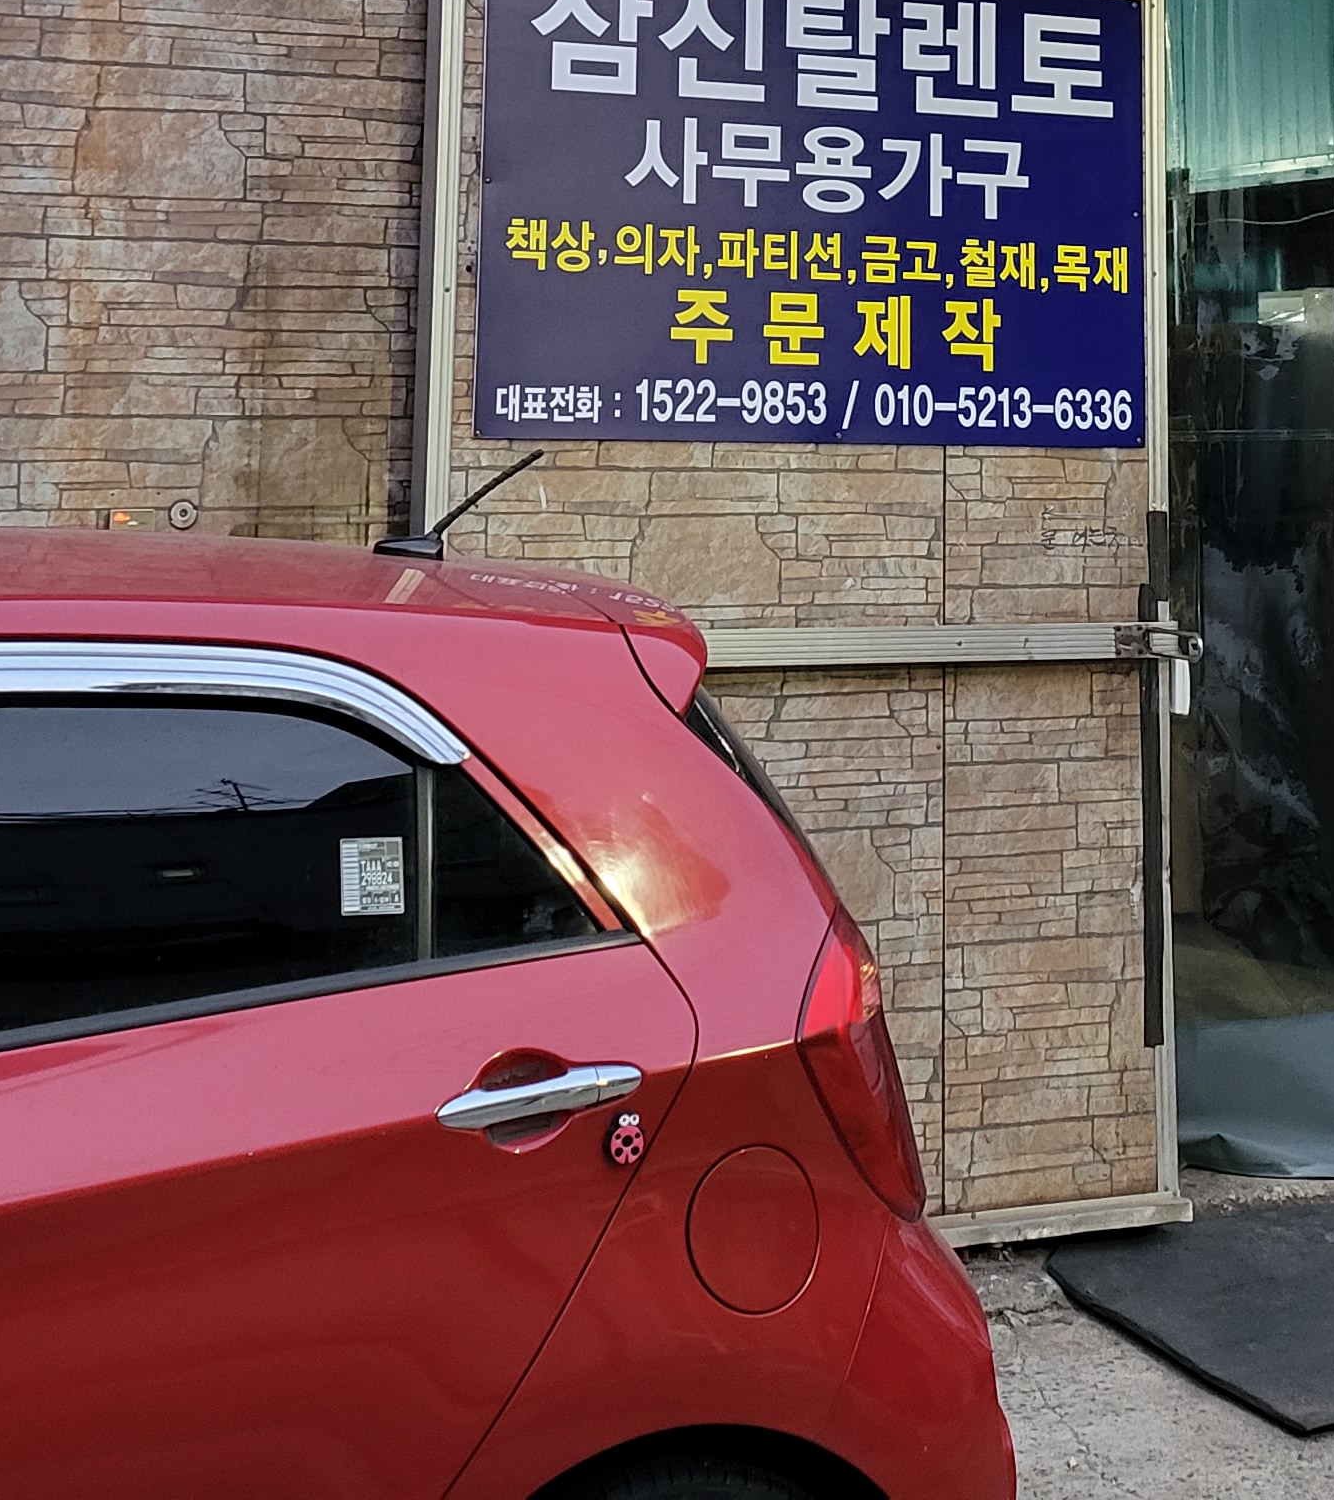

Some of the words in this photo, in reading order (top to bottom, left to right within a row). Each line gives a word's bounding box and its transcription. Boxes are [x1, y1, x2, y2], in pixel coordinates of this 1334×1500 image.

[624, 117, 1030, 220] 사무용가구
[495, 383, 603, 425] 대표전화
[635, 378, 827, 426] 1522-9853
[874, 383, 1132, 431] 010-5213-6336
